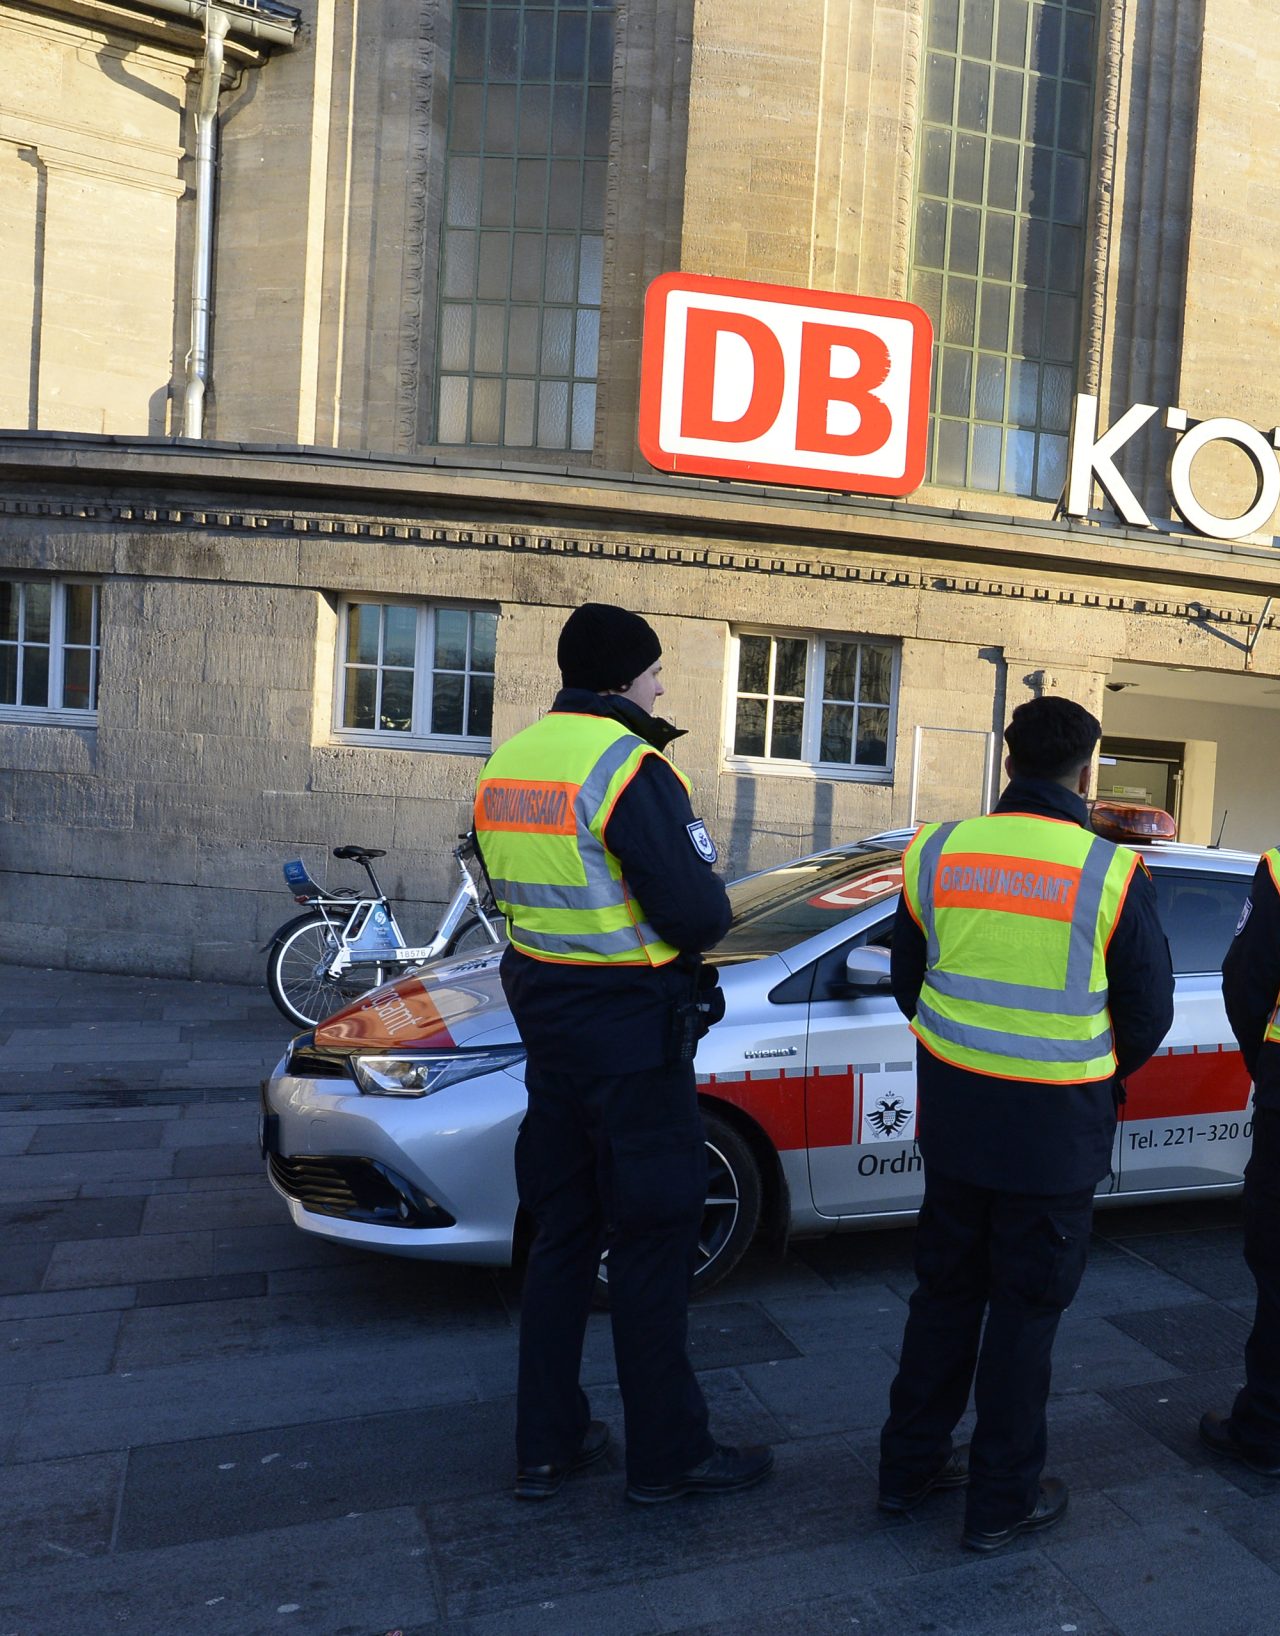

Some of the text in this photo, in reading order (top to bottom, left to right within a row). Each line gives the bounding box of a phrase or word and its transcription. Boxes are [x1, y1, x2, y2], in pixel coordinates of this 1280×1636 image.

[680, 306, 893, 457] DB
[483, 787, 568, 826] ORDNUNGSAMT
[940, 866, 1073, 905] ORDNUNGSAMT
[399, 950, 427, 958] 18576
[1129, 1130, 1158, 1150] Tel.
[857, 1150, 922, 1177] Ordn
